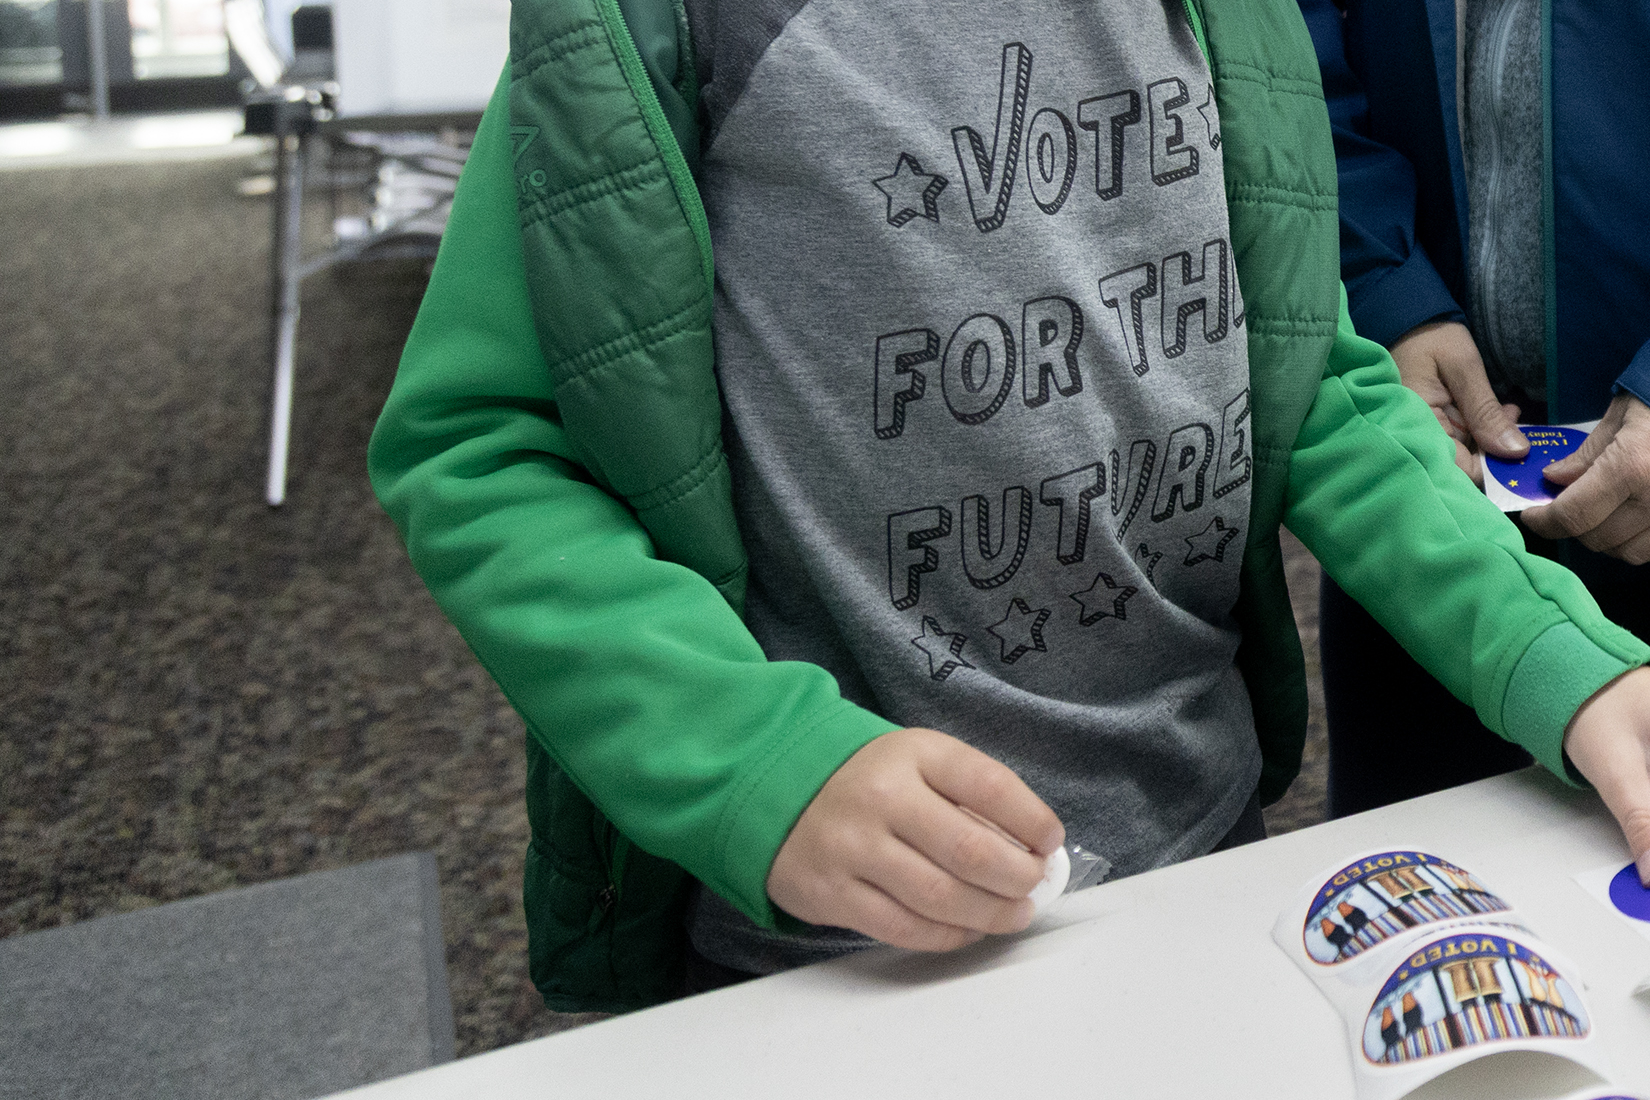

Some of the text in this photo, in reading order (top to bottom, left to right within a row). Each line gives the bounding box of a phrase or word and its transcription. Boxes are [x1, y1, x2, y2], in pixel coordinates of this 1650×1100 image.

[950, 41, 1200, 233] VOTE
[873, 295, 1084, 440] FOR
[1530, 439, 1560, 447] Vote
[887, 388, 1252, 612] FUTURE
[1333, 853, 1427, 886] I VOTED
[1410, 939, 1517, 969] I VOTED
